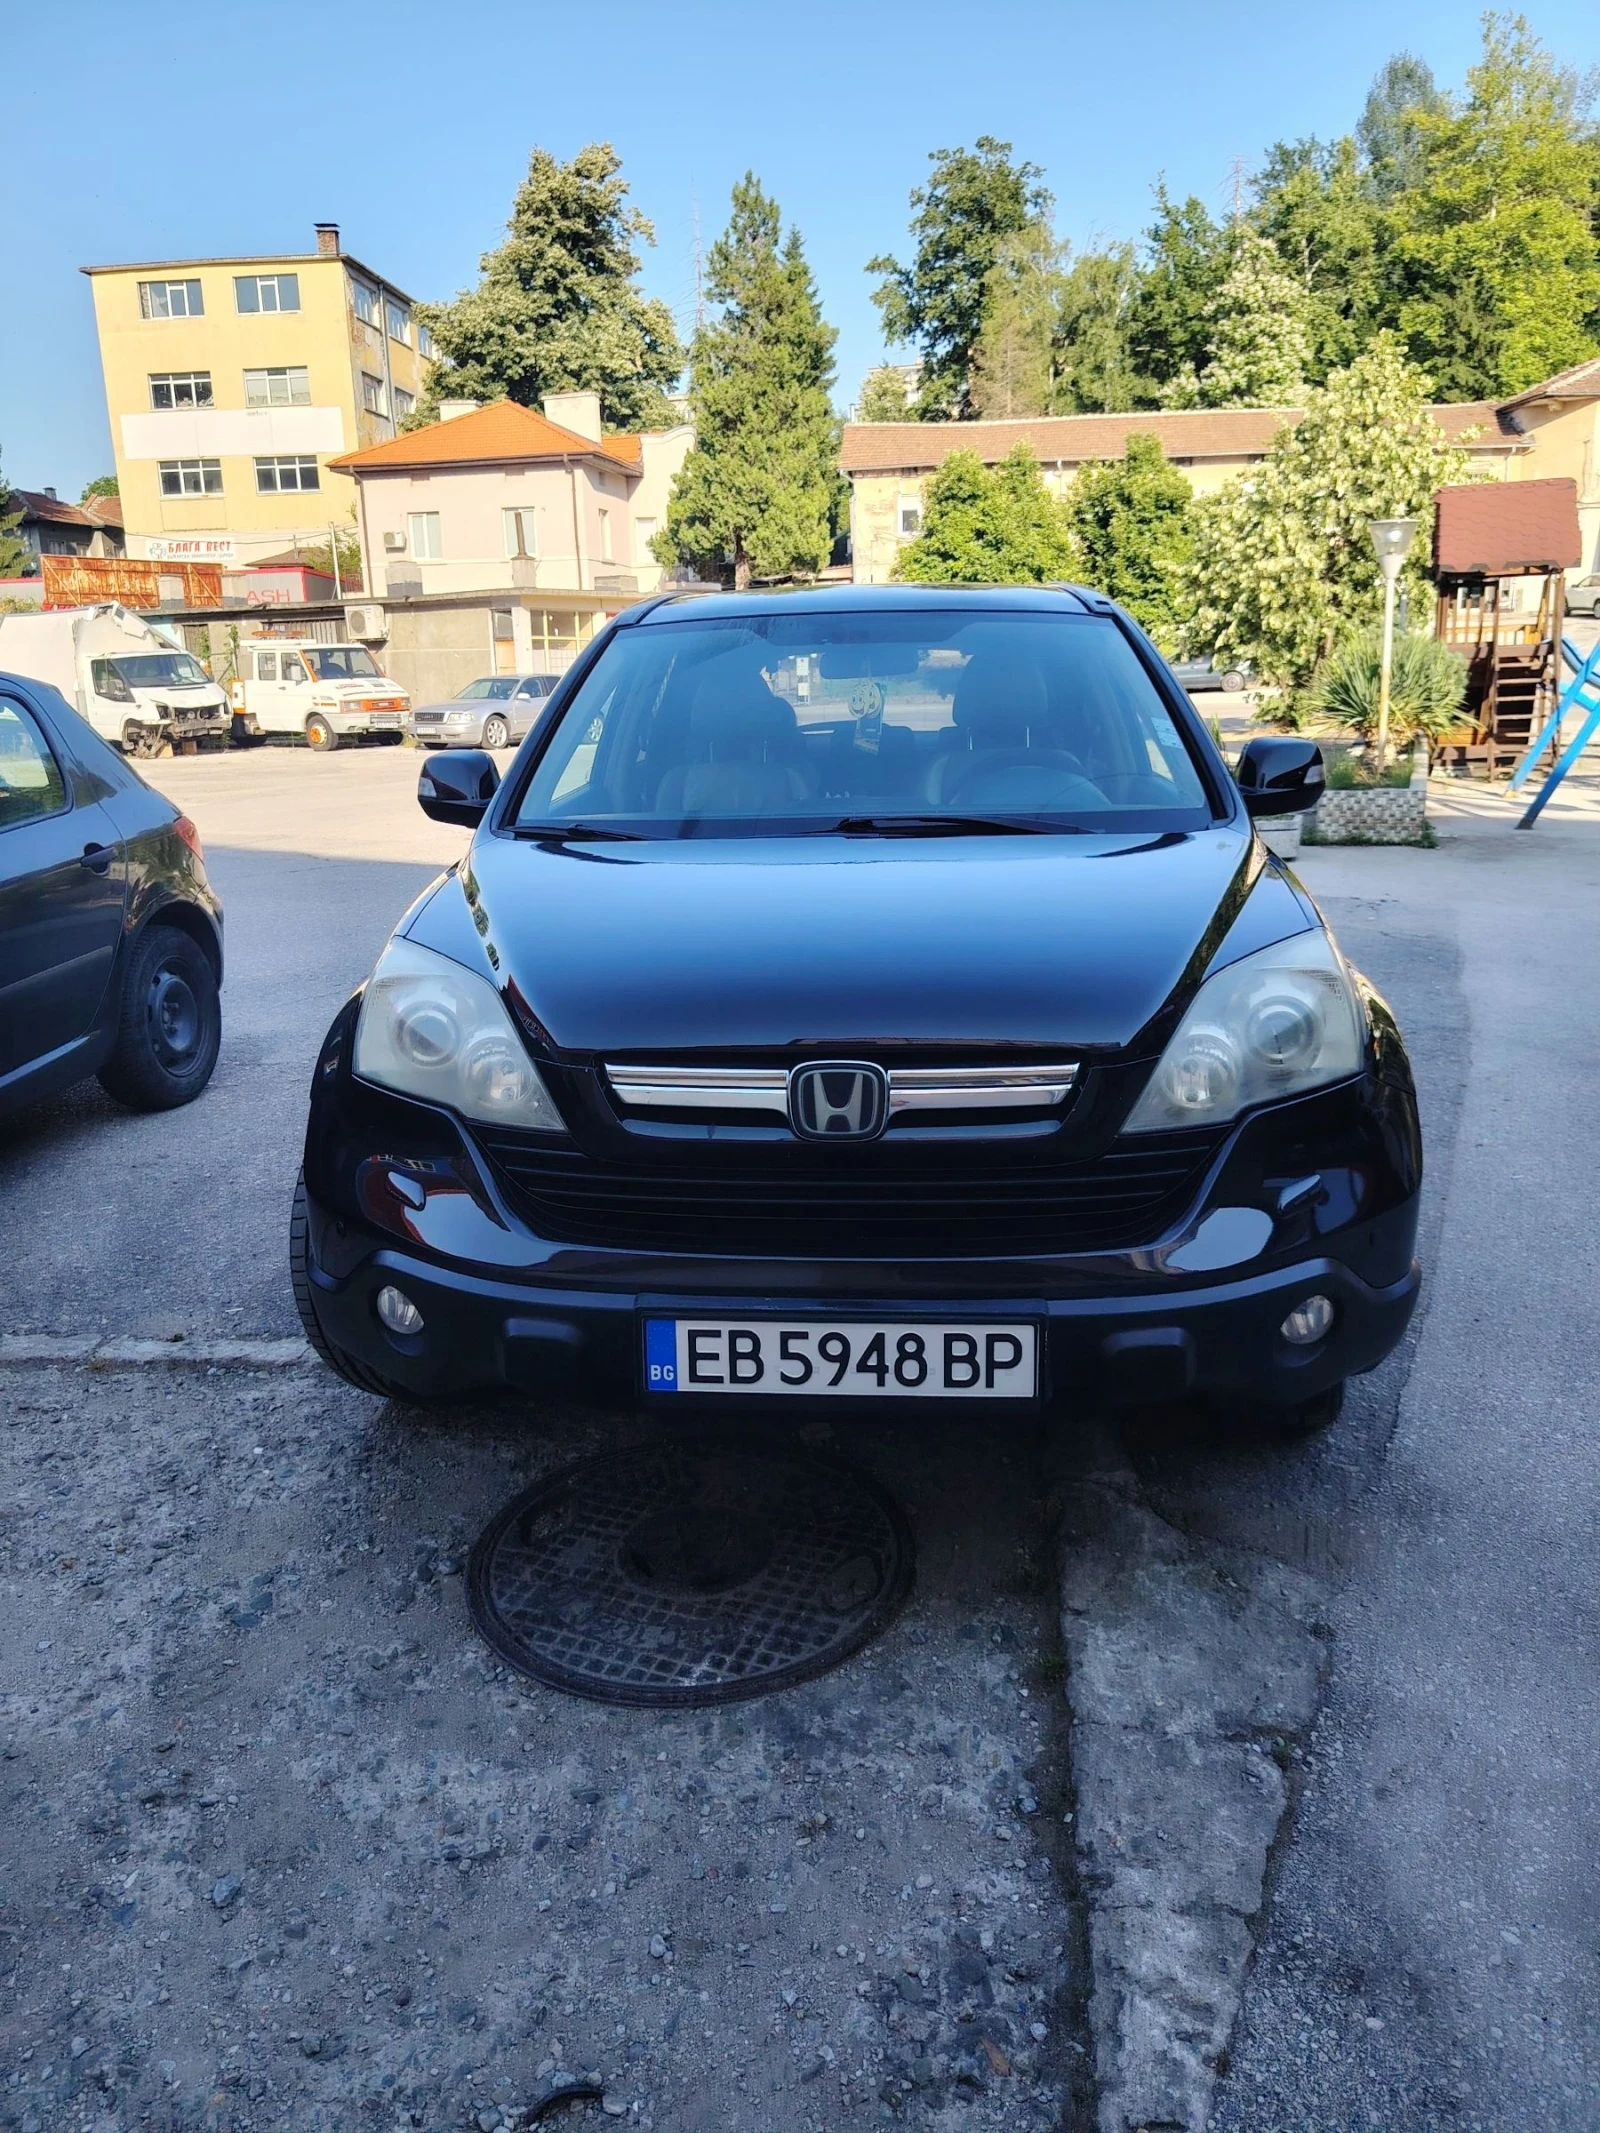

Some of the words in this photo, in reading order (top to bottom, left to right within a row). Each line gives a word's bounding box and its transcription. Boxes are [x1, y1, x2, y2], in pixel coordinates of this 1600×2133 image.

[168, 541, 200, 553] БЛАГА
[206, 541, 232, 552] ВЕСТ
[687, 1329, 764, 1384] EB
[780, 1331, 927, 1387] 5948
[943, 1332, 1022, 1389] BP
[650, 1364, 675, 1382] BG
